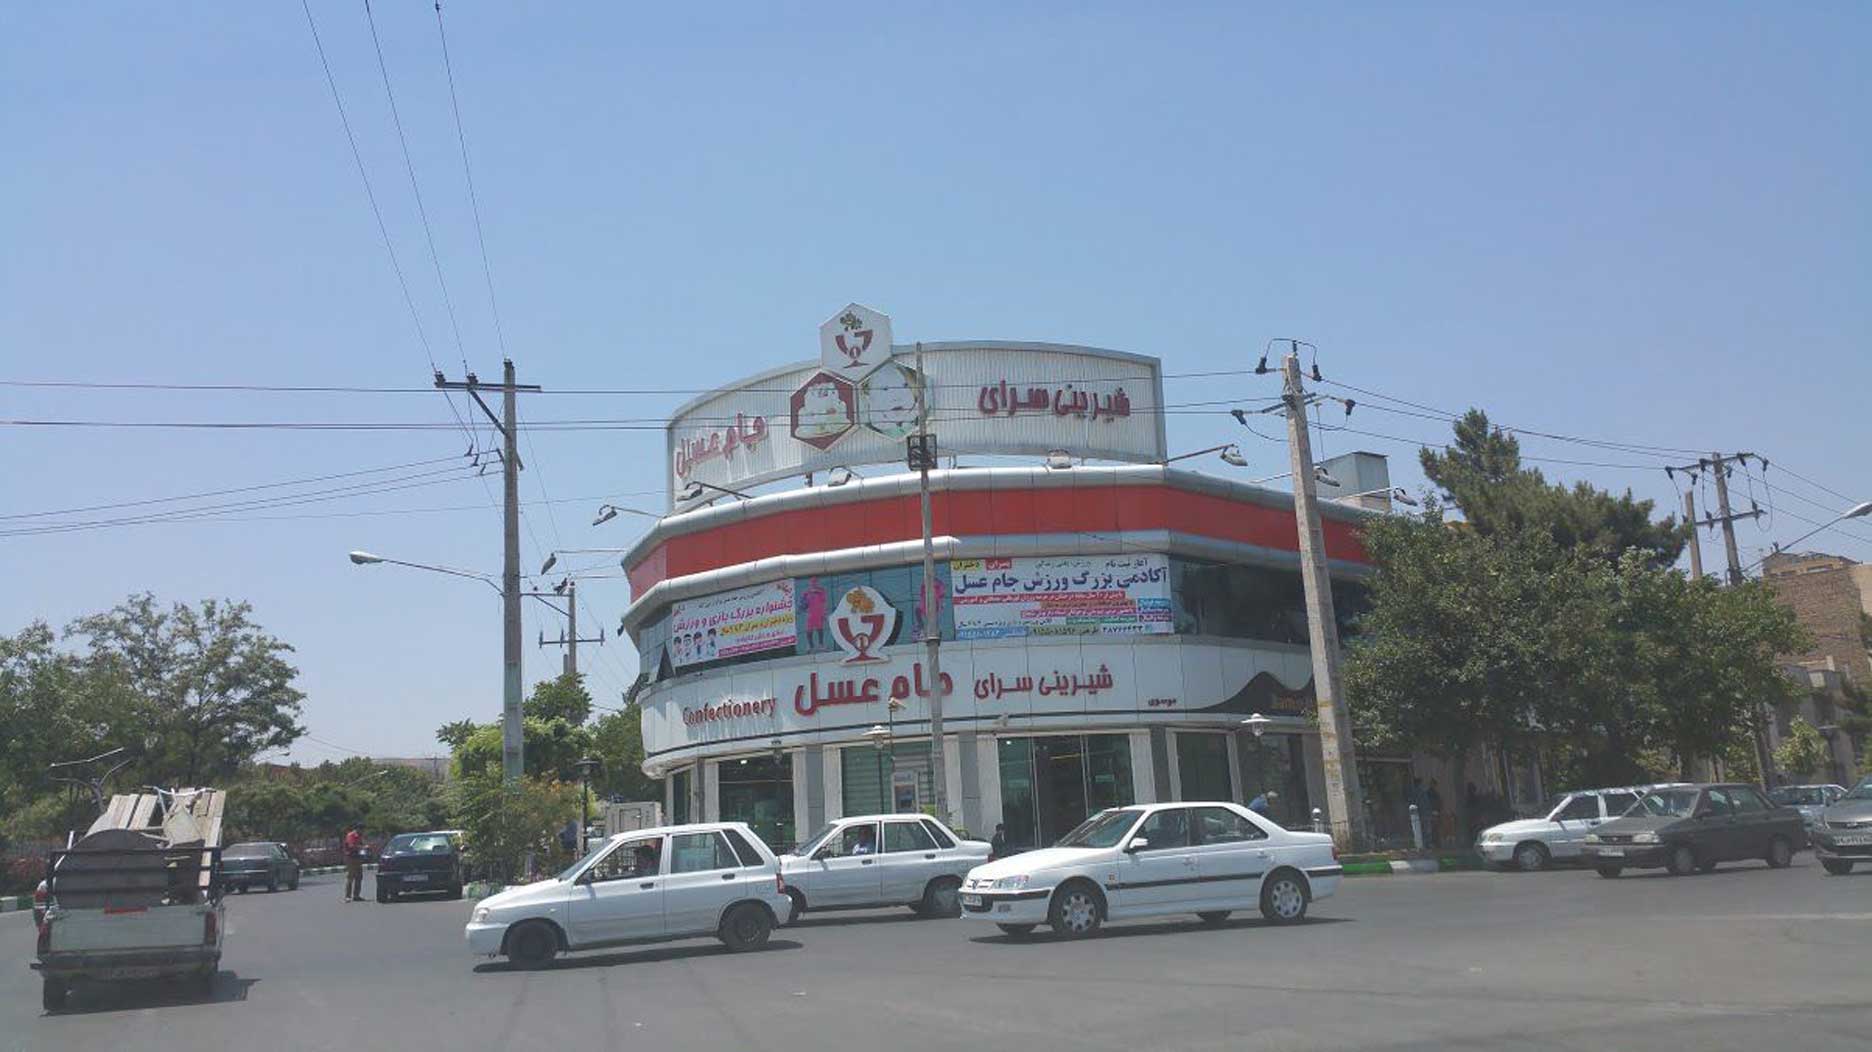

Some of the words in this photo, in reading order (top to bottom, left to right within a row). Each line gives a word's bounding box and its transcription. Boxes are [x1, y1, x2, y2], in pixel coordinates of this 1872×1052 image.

[978, 379, 1049, 417] سرای
[675, 432, 722, 478] عسل
[954, 575, 987, 594] عسل
[992, 573, 1018, 593] جام
[1024, 572, 1068, 592] ورزش
[1072, 570, 1113, 590] بزرگ
[1117, 566, 1166, 588] آکادمی
[972, 672, 1031, 700] سرای
[1037, 664, 1112, 696] شیرینی
[793, 672, 878, 717] عسل
[682, 697, 775, 727] Confectionery
